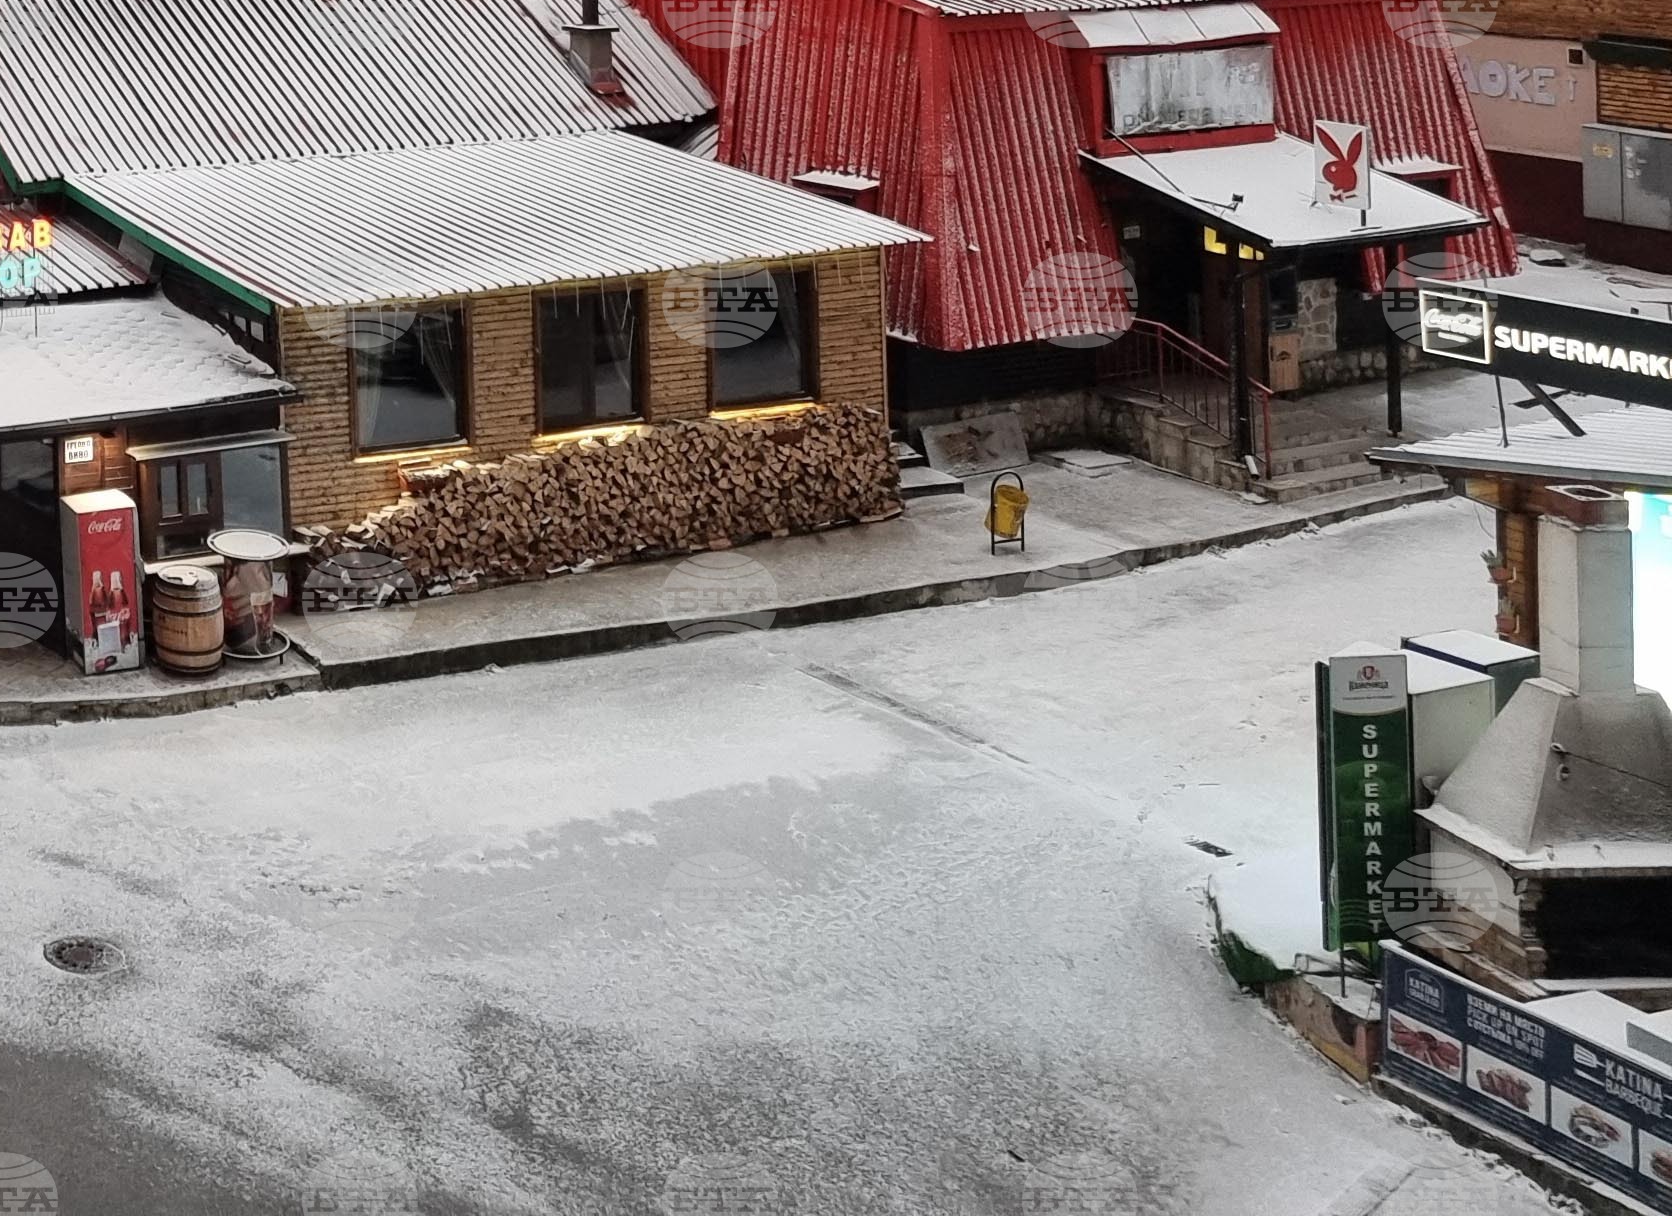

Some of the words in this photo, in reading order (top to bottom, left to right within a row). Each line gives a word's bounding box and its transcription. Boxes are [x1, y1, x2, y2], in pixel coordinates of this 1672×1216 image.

[1494, 325, 1672, 380] SUPERMARK
[1361, 723, 1384, 934] SUPERMARKET
[1490, 1015, 1504, 1031] UP
[1605, 1058, 1665, 1102] KATINA
